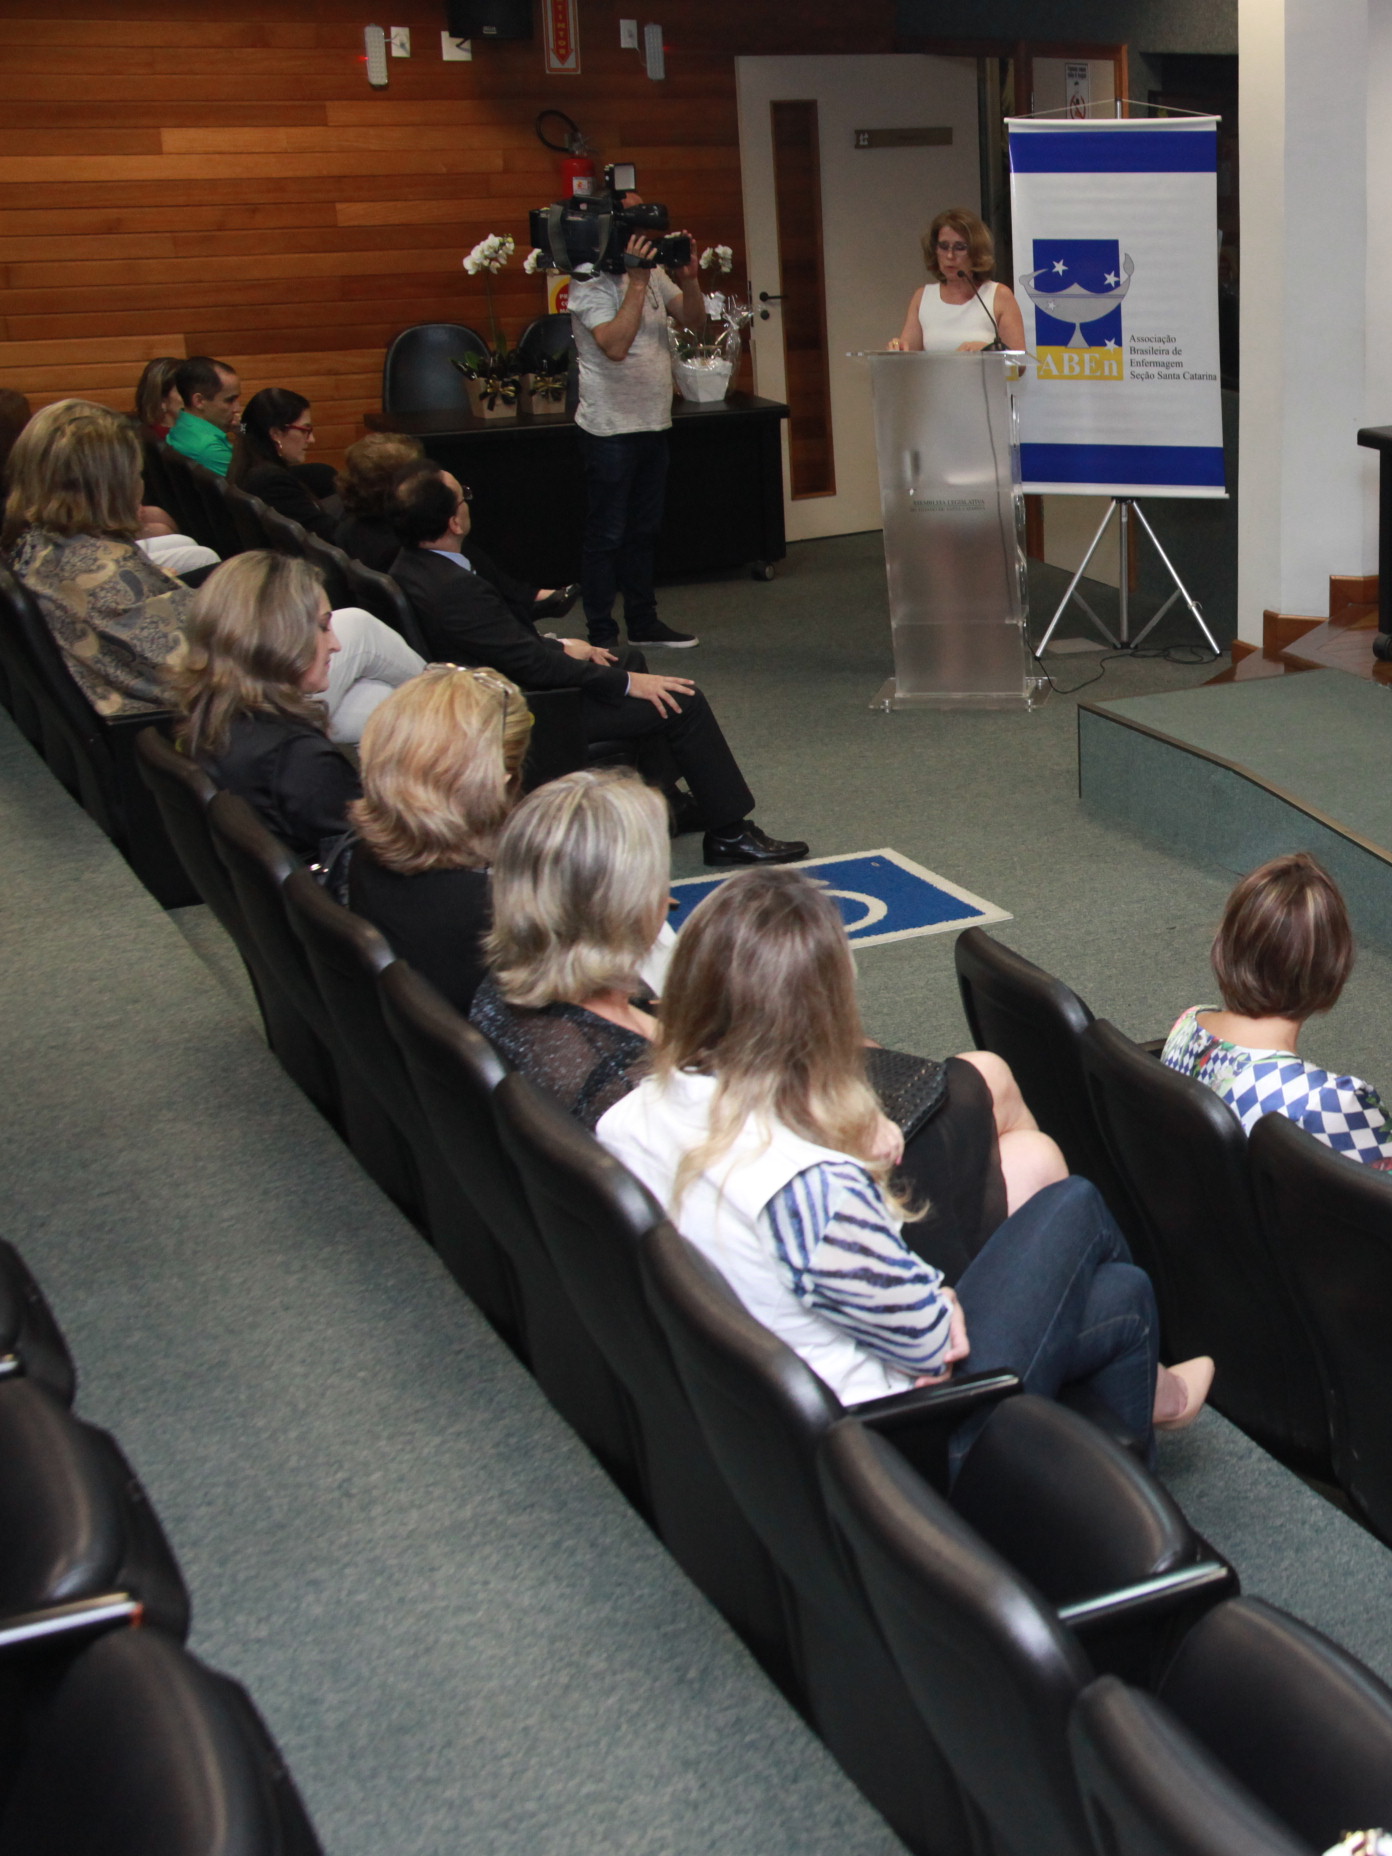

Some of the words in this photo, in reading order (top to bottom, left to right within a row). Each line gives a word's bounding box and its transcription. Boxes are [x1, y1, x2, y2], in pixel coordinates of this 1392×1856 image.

[556, 0, 567, 55] TINTOR
[1129, 334, 1177, 344] Associação
[1129, 346, 1169, 356] Brasileira
[1171, 346, 1182, 356] de
[1039, 352, 1119, 377] ABEn
[1129, 358, 1183, 370] Enfermagem
[1129, 371, 1155, 382] Seção
[1157, 371, 1180, 381] Santa
[1182, 371, 1217, 381] Catarina
